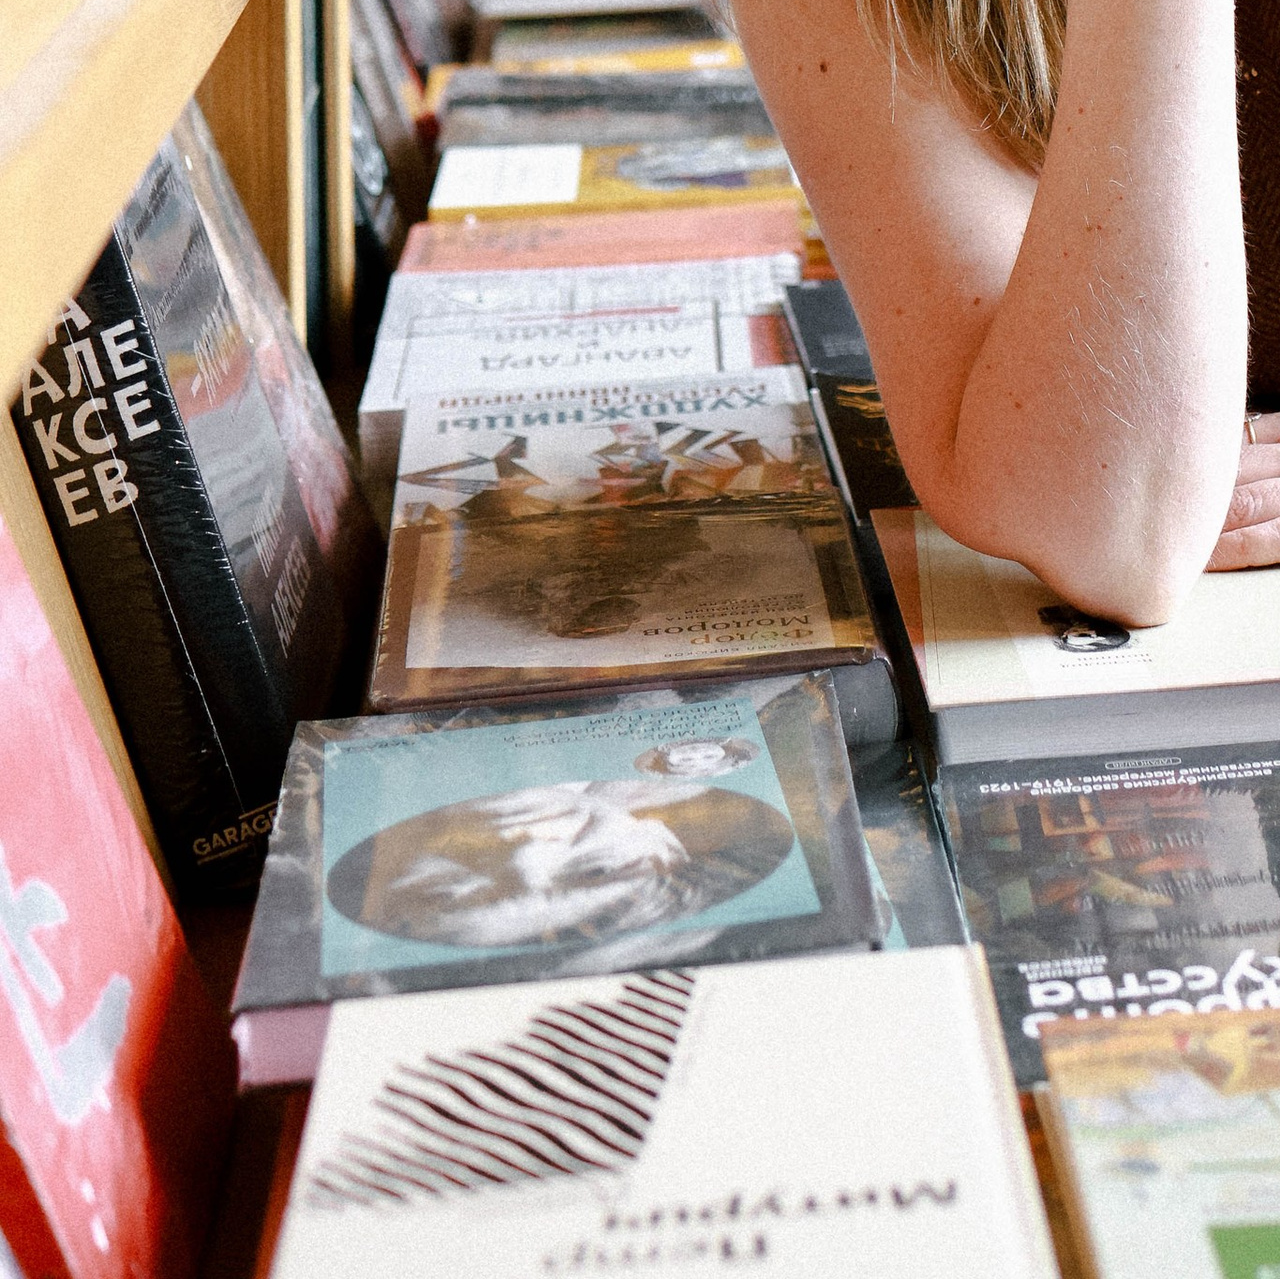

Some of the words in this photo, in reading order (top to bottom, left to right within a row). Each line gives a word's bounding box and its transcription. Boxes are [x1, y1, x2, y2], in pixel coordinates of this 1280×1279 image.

[479, 346, 692, 372] АВАНГАРД
[437, 394, 768, 434] ХУДОЖНИЦЫ
[643, 614, 810, 636] Модоров
[689, 628, 814, 646] Фёдор
[1123, 768, 1272, 789] екатеринбургские
[1030, 783, 1119, 796] свободные
